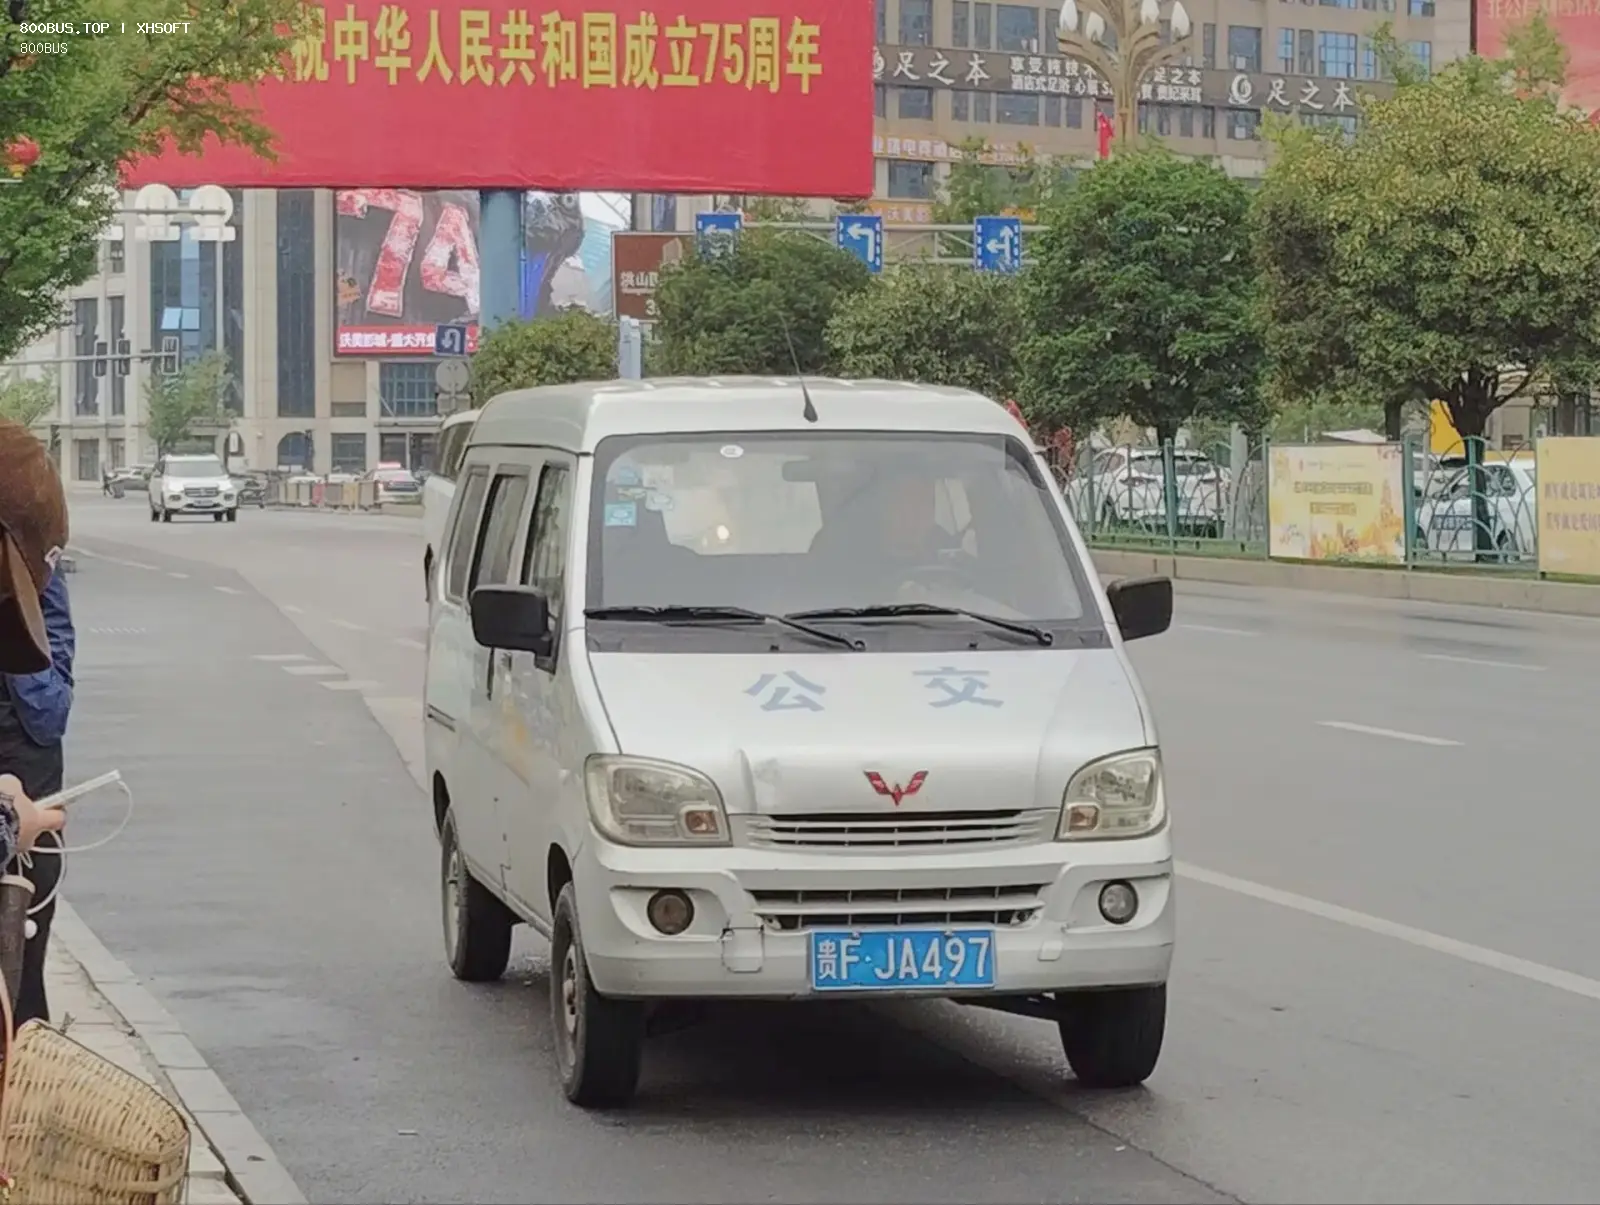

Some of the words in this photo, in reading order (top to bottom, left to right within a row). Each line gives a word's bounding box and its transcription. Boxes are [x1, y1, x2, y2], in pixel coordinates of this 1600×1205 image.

[893, 51, 991, 87] 足之本
[1267, 78, 1355, 112] 足之本
[742, 666, 1004, 712] 公交
[816, 936, 990, 980] 贵F·JA497
